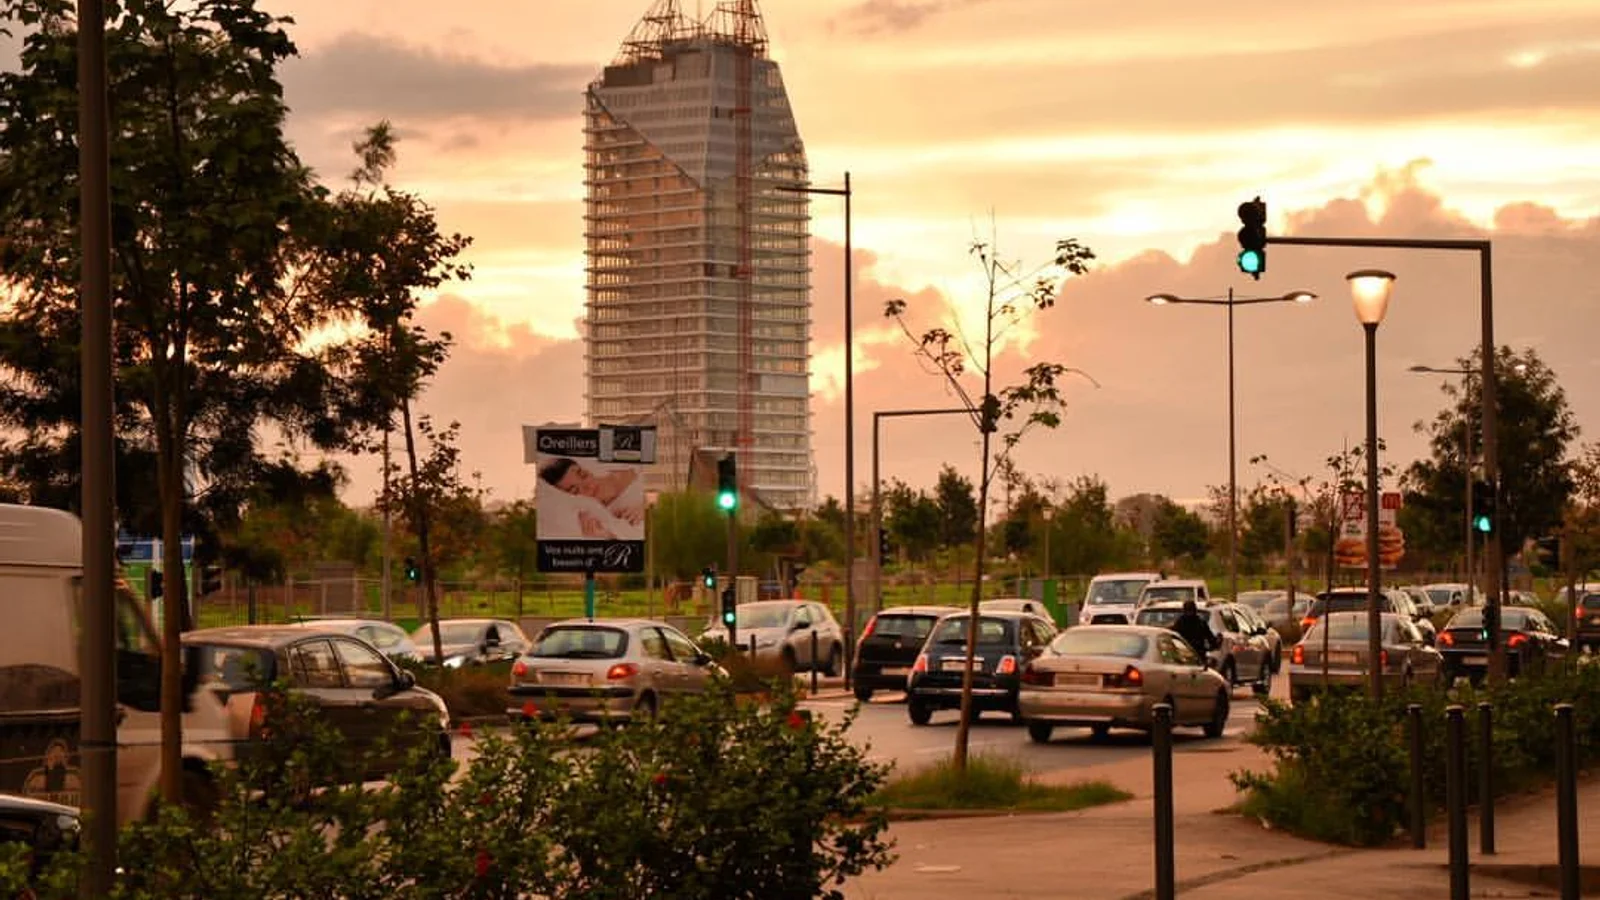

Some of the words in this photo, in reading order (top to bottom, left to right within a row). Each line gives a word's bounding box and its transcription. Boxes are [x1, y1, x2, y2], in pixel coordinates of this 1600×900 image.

[540, 435, 597, 450] Oreillers
[563, 544, 584, 554] nuits
[587, 545, 604, 554] ont
[552, 557, 583, 567] besoin
